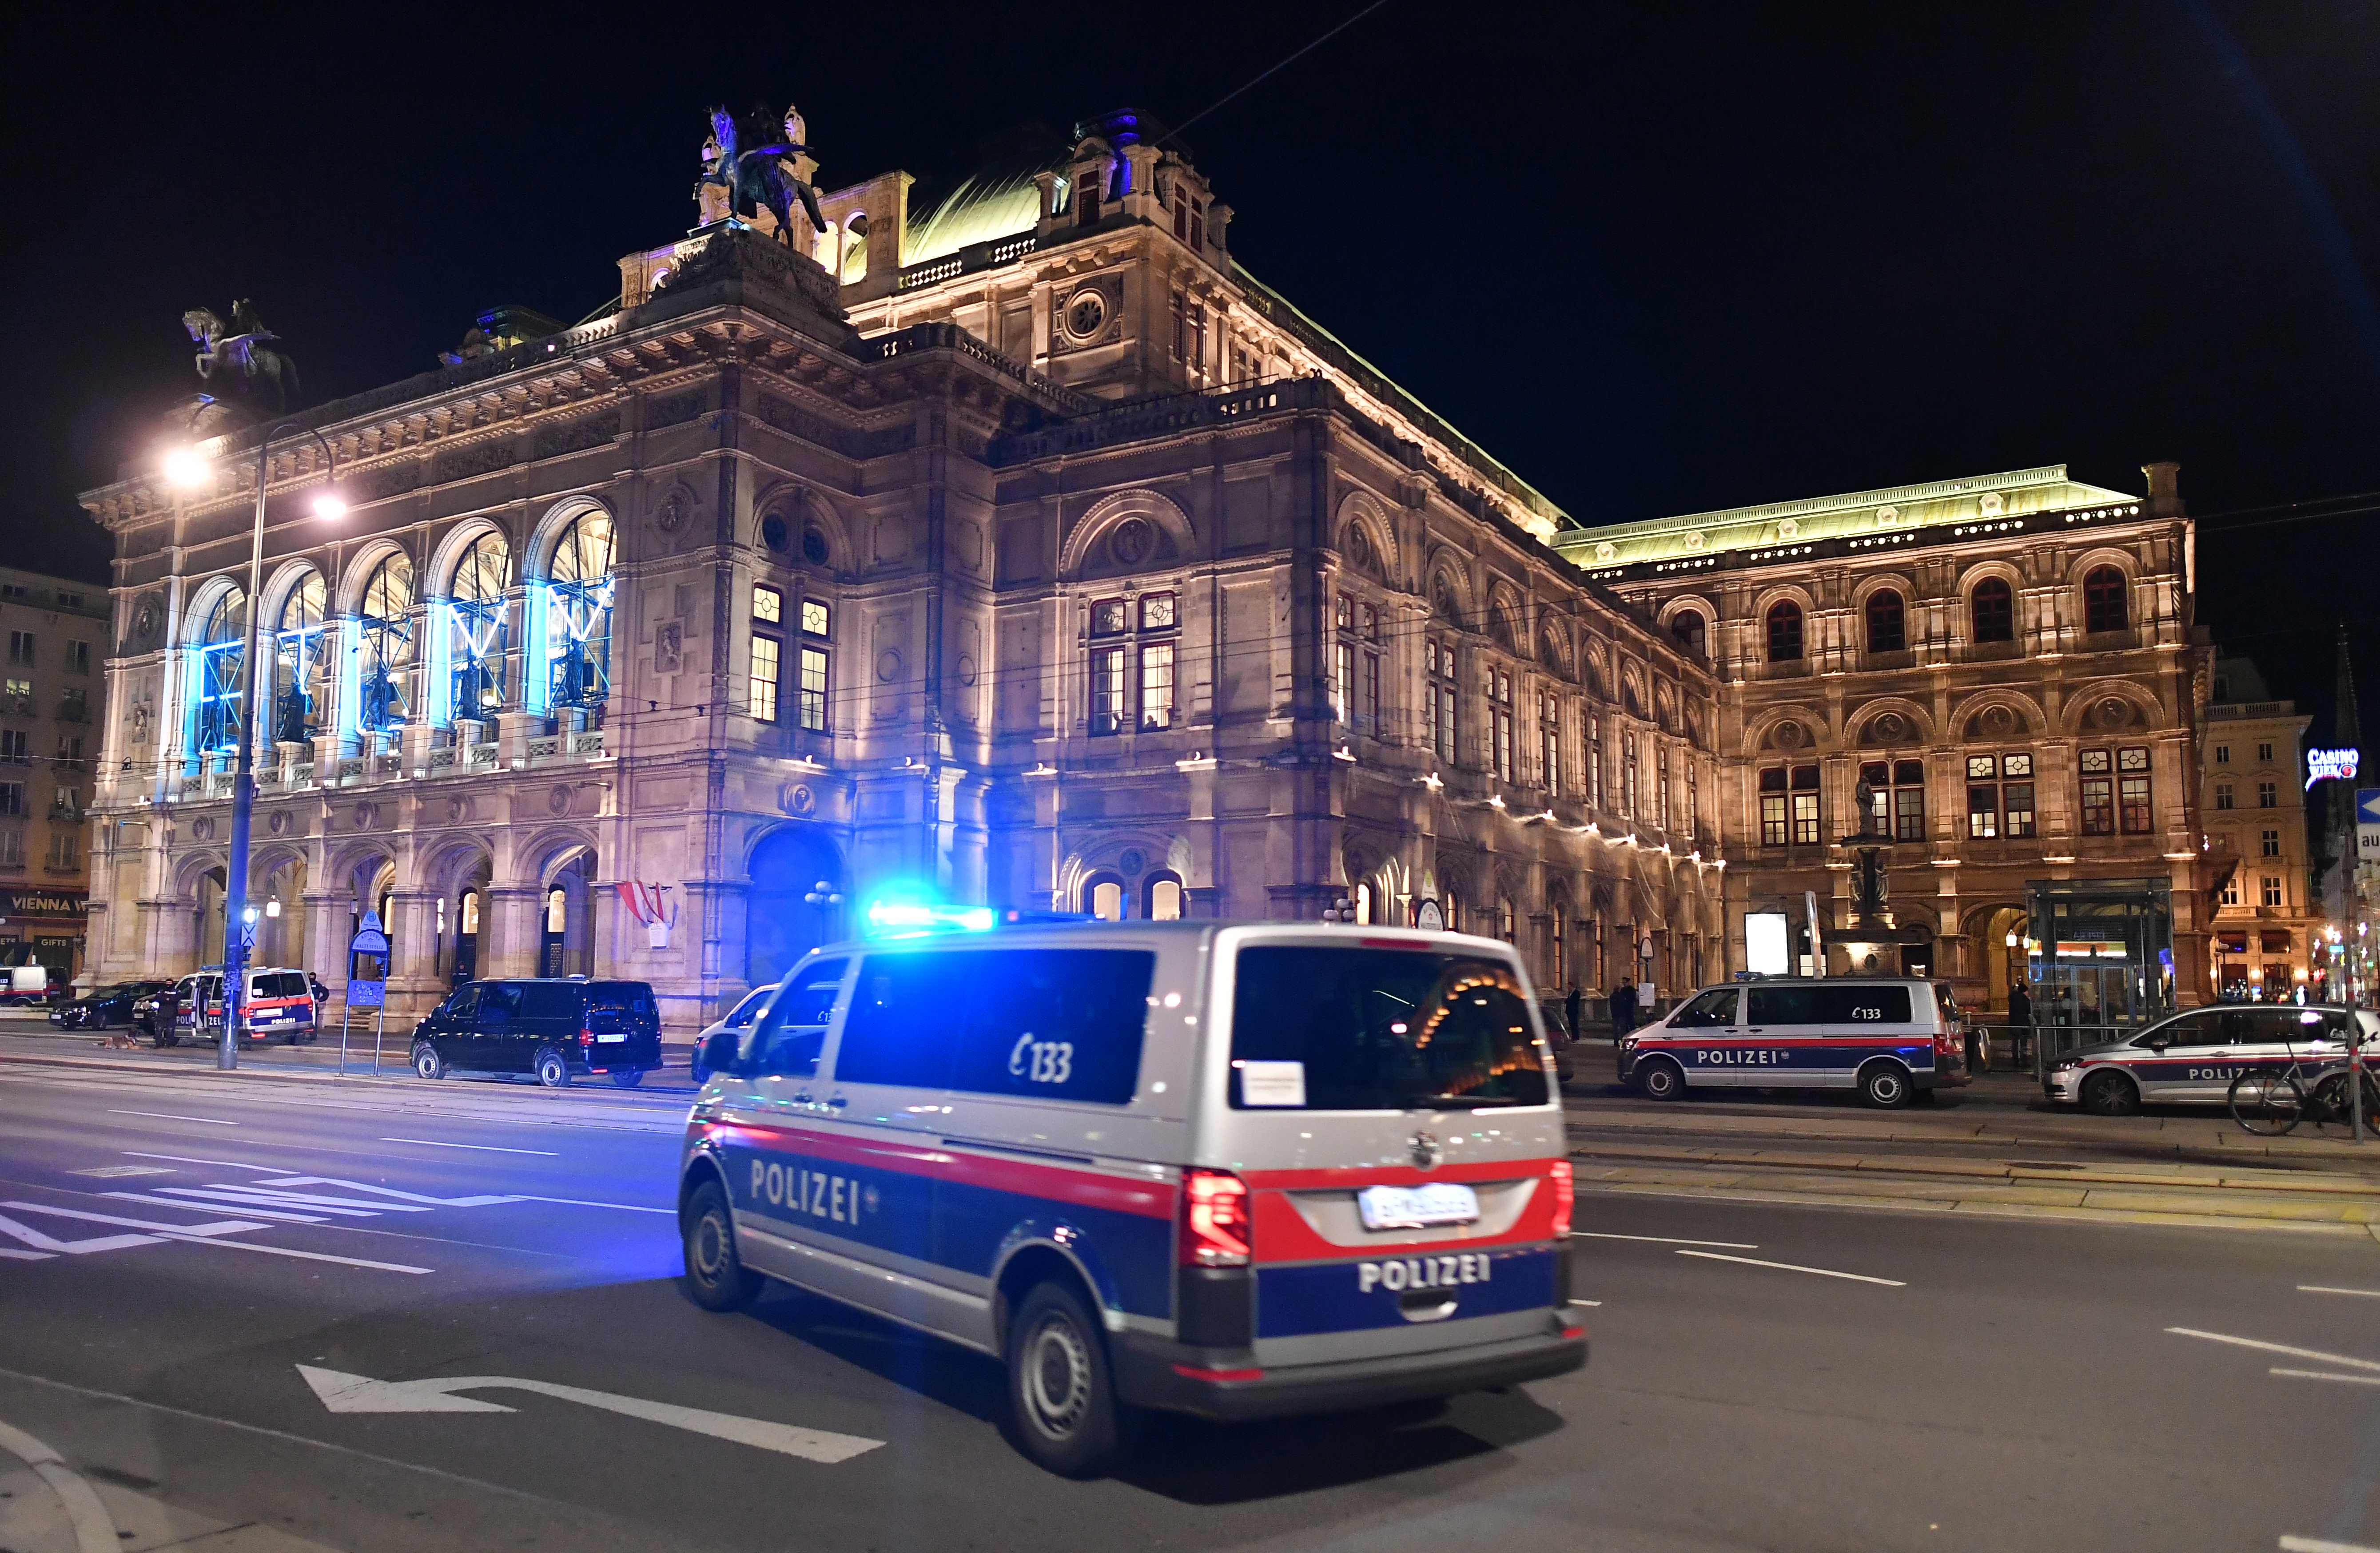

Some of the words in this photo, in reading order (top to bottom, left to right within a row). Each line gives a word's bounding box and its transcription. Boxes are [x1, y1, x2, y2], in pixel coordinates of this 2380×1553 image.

[2308, 748, 2358, 765] CASINO
[12, 897, 70, 911] VIENNA
[1861, 1009, 1881, 1019] 133
[1030, 1042, 1074, 1084] 133
[1697, 1050, 1776, 1064] POLIZEI
[2189, 1068, 2257, 1080] POLIZ
[751, 1159, 858, 1226] POLIZEI
[1358, 1253, 1491, 1293] POLIZEI
